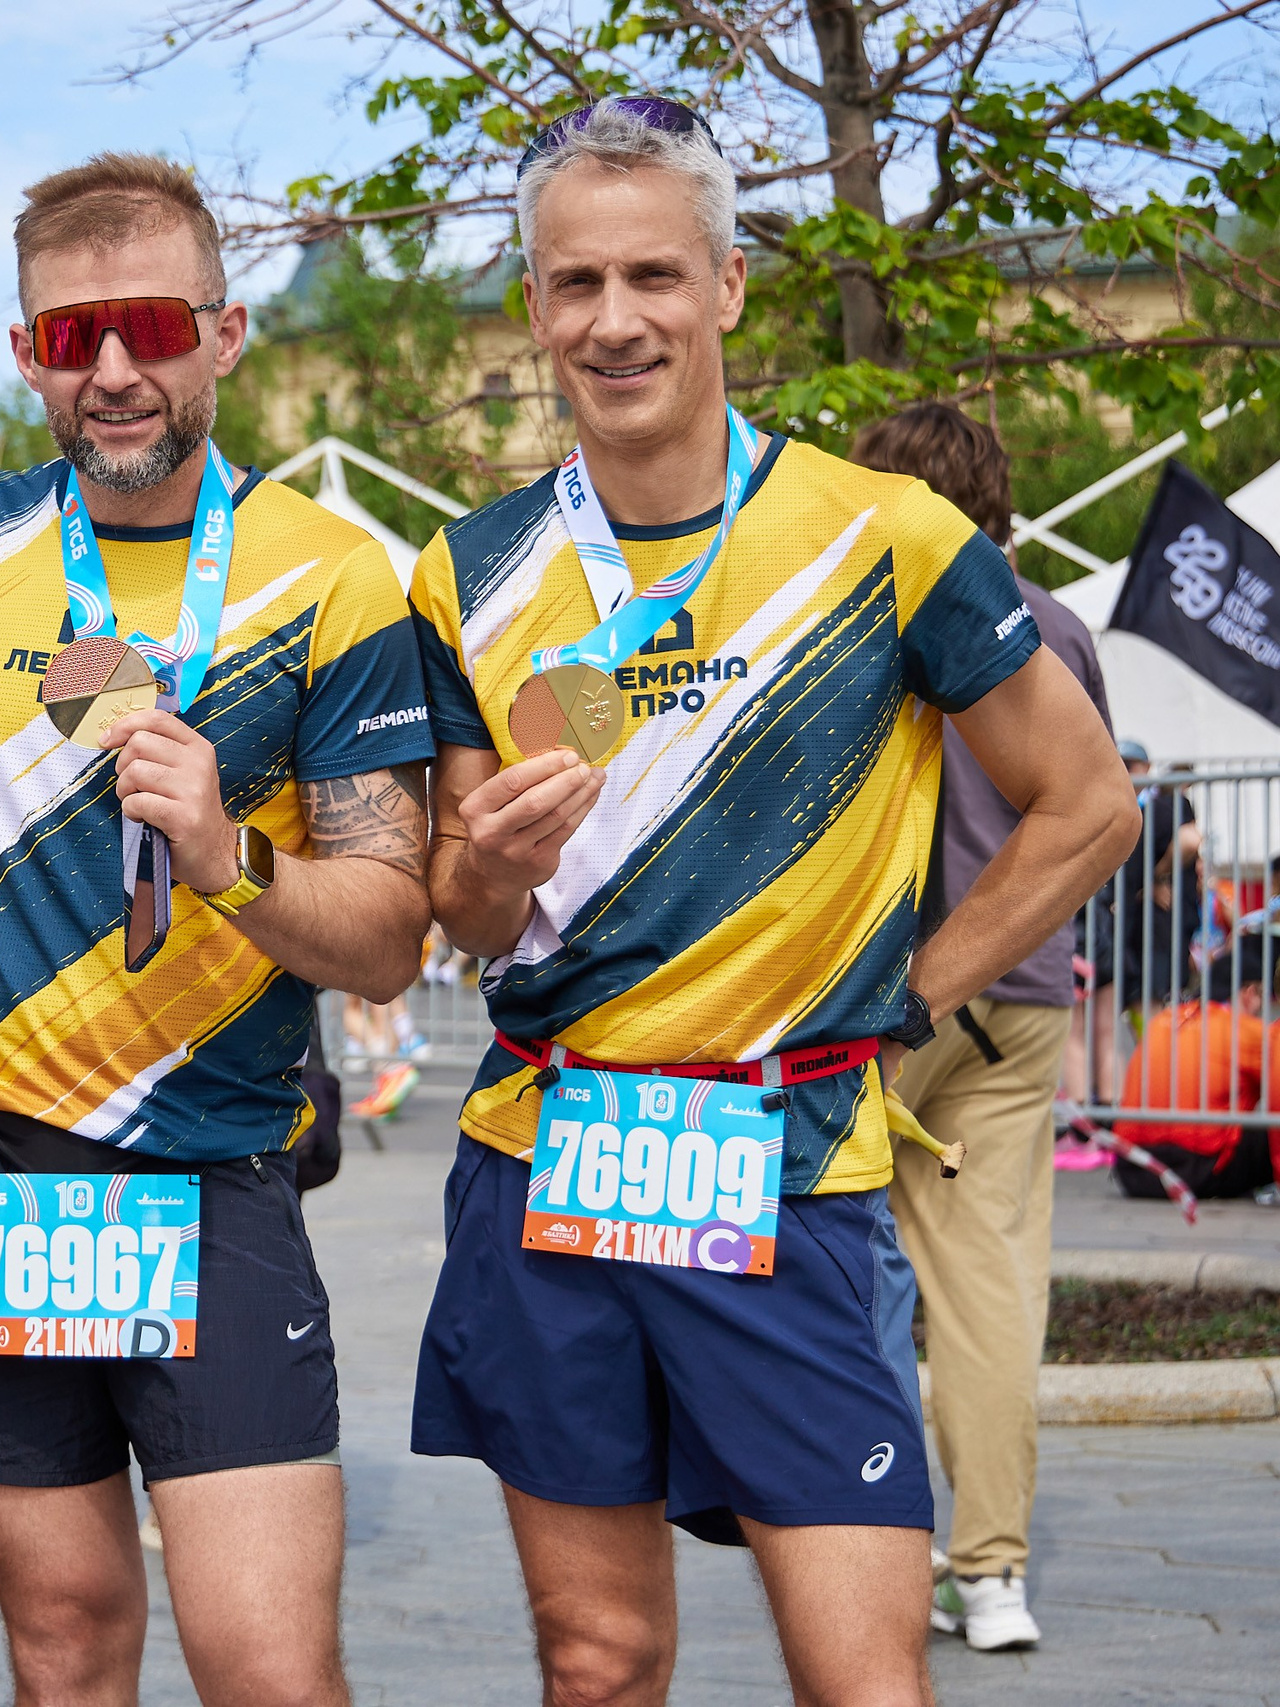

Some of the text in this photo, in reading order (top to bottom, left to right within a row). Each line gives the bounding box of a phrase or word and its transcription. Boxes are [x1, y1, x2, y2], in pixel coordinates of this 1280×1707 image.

[562, 466, 587, 511] ПСБ
[727, 471, 741, 517] ПСБ
[67, 516, 89, 561] ПСБ
[201, 508, 227, 554] ПСБ
[994, 601, 1031, 641] ЛЕМАН
[609, 656, 748, 690] ЕМАНА
[631, 688, 706, 718] ПРО
[790, 1050, 849, 1076] IRONMAN
[564, 1086, 592, 1102] ПСБ
[635, 1081, 677, 1121] 10
[546, 1119, 766, 1226] 76909
[53, 1180, 95, 1218] 10
[592, 1217, 740, 1273] 21.1KM C
[23, 1316, 171, 1358] 21.1KM D
